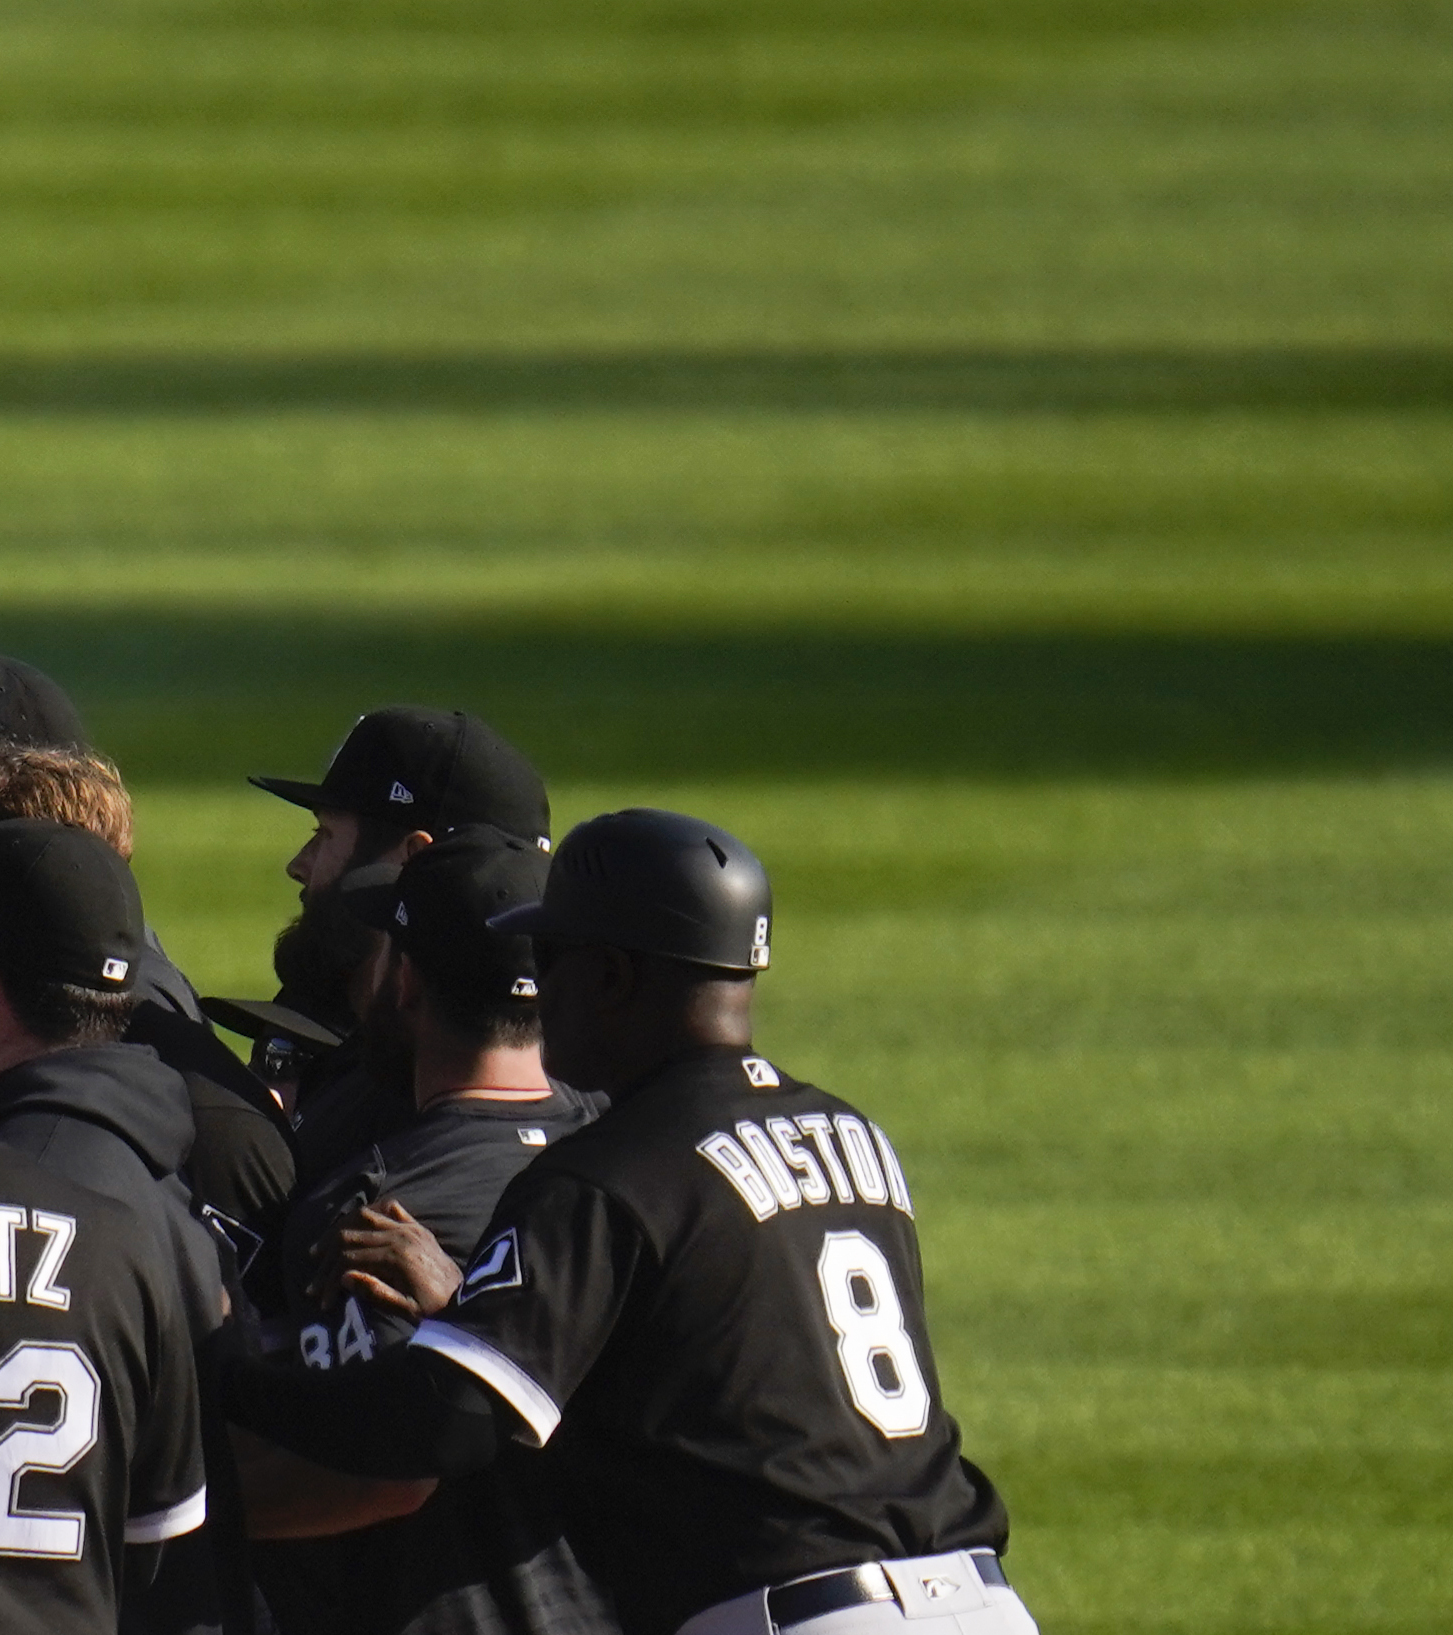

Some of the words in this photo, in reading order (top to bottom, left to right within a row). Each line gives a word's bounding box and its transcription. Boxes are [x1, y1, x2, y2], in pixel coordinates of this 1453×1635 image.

[754, 915, 768, 946] 8
[696, 1112, 915, 1223] BOSTON
[817, 1230, 931, 1439] 8
